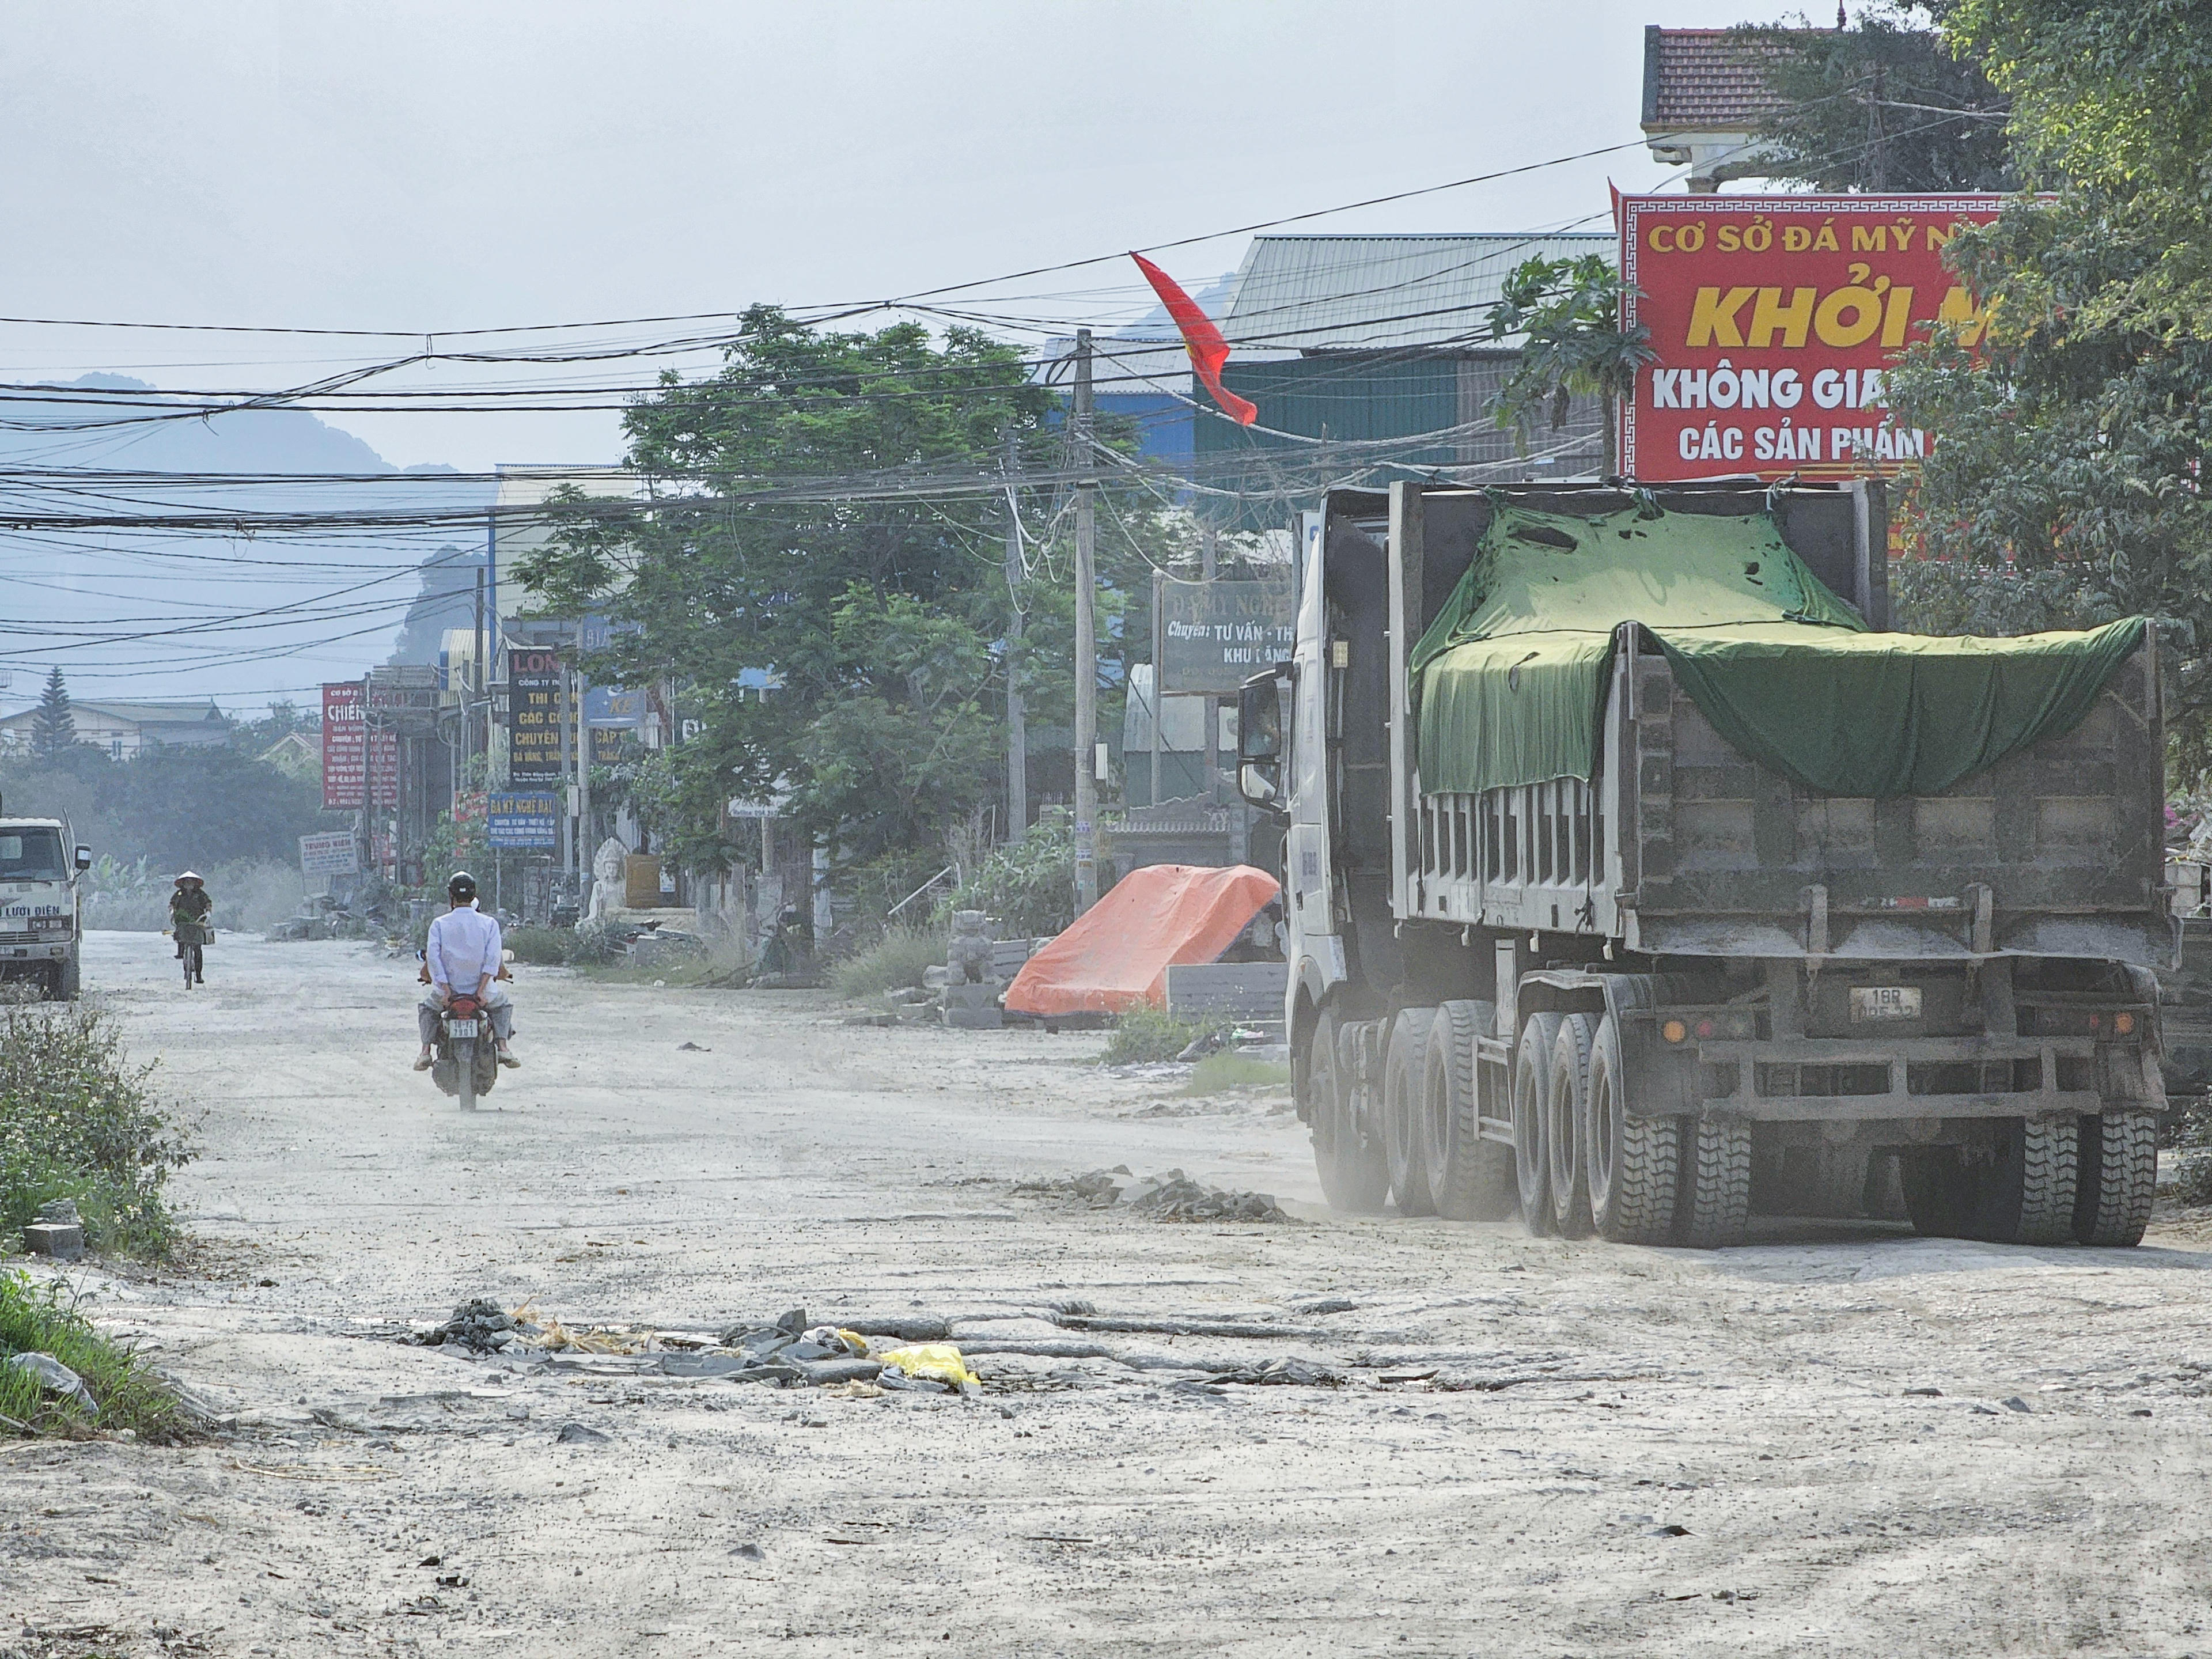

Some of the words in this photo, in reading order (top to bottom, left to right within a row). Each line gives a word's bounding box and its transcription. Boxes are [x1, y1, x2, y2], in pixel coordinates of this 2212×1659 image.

[1648, 220, 1706, 252] CƠ
[1716, 215, 1773, 252] SỞ
[1782, 218, 1840, 251] ĐÁ
[1851, 217, 1916, 251] MỸ
[1685, 263, 1914, 348] KHỞI
[1652, 359, 1803, 409] KHÔNG
[1812, 368, 1895, 409] GIA
[1679, 421, 1743, 460] CÁC
[1754, 416, 1821, 461] SẢN
[1831, 412, 1925, 460] PHẨM
[1214, 623, 1233, 641] TƯ
[1236, 620, 1262, 641] VẤN
[1224, 647, 1252, 663] KHU
[528, 693, 548, 704] THI
[515, 730, 558, 745] CHUYÊN
